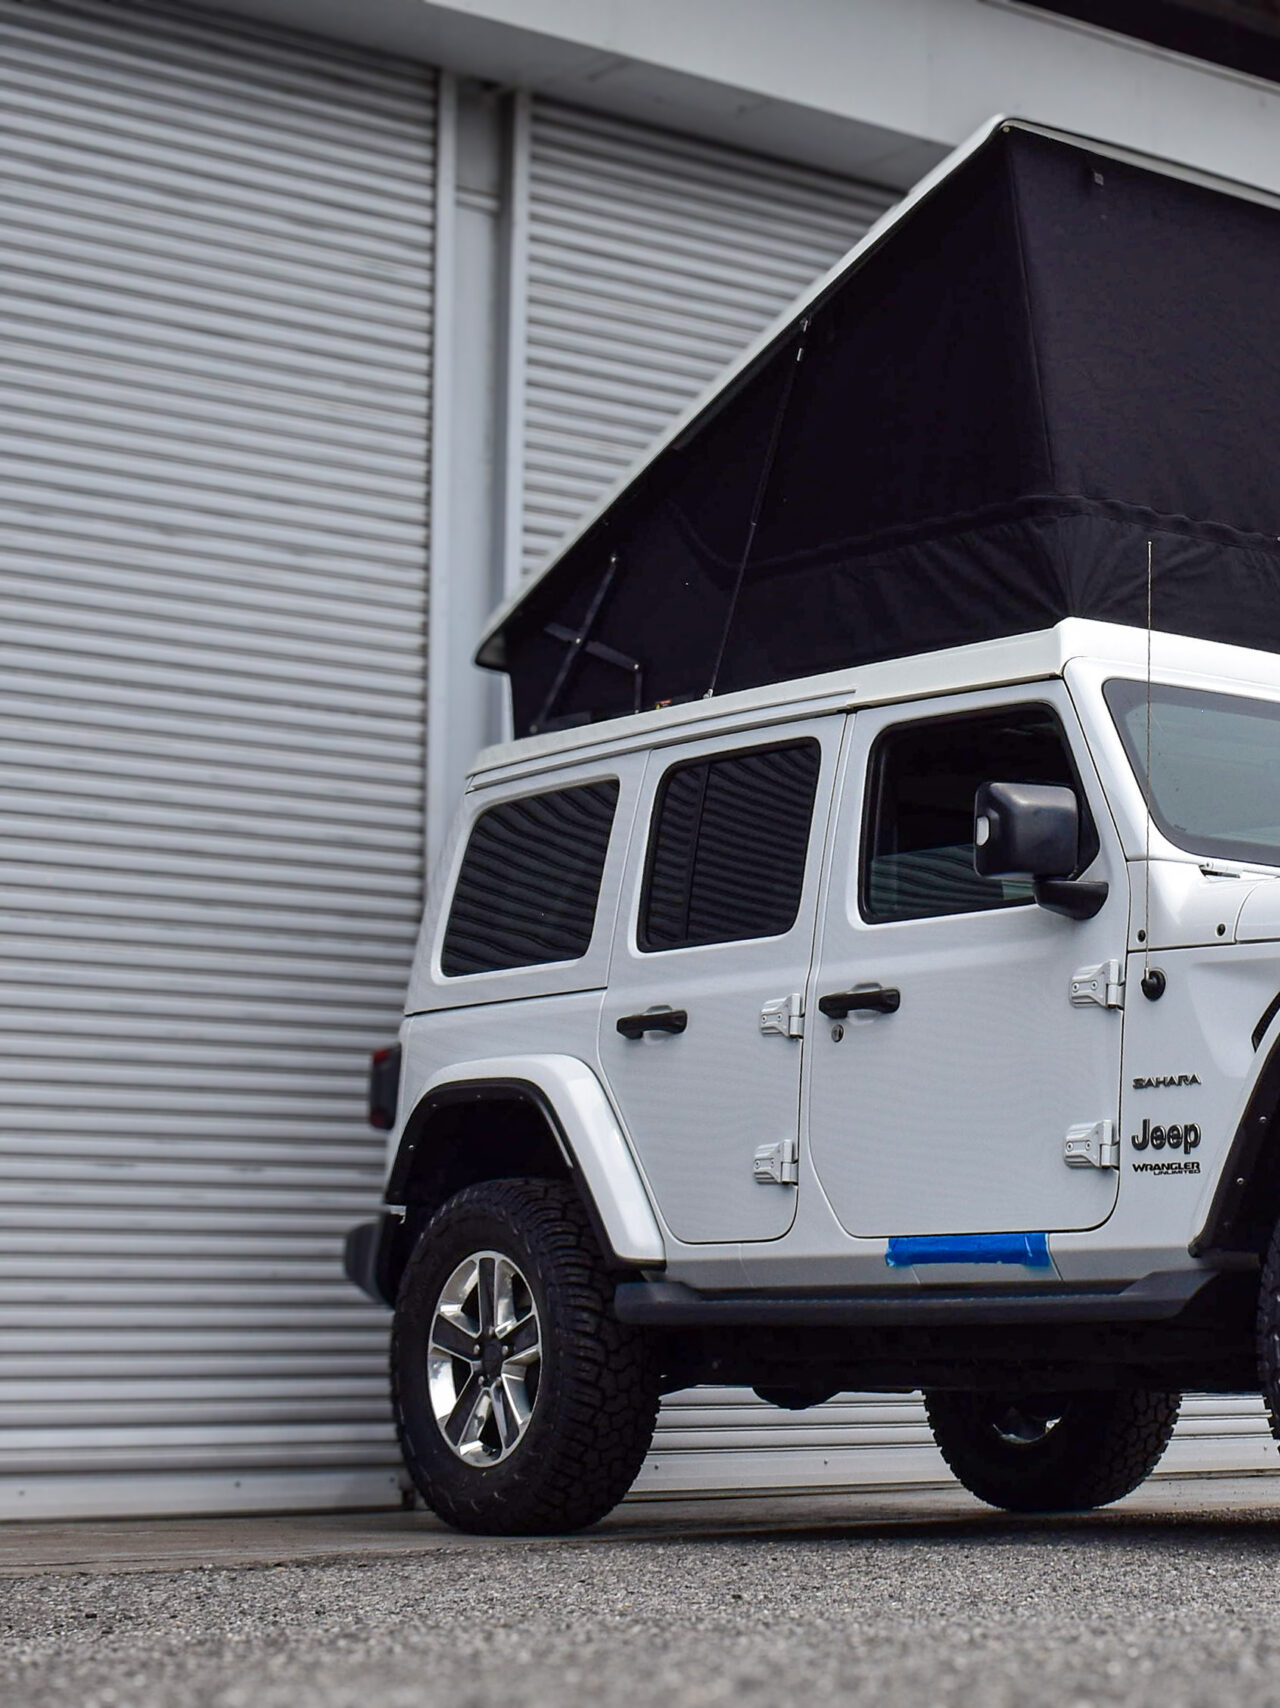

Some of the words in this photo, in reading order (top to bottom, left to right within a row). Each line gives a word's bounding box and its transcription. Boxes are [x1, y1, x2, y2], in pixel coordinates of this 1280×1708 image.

[1132, 1074, 1201, 1089] SAHARA
[1131, 1118, 1202, 1155] Jeep
[1132, 1162, 1201, 1172] WRANGLER
